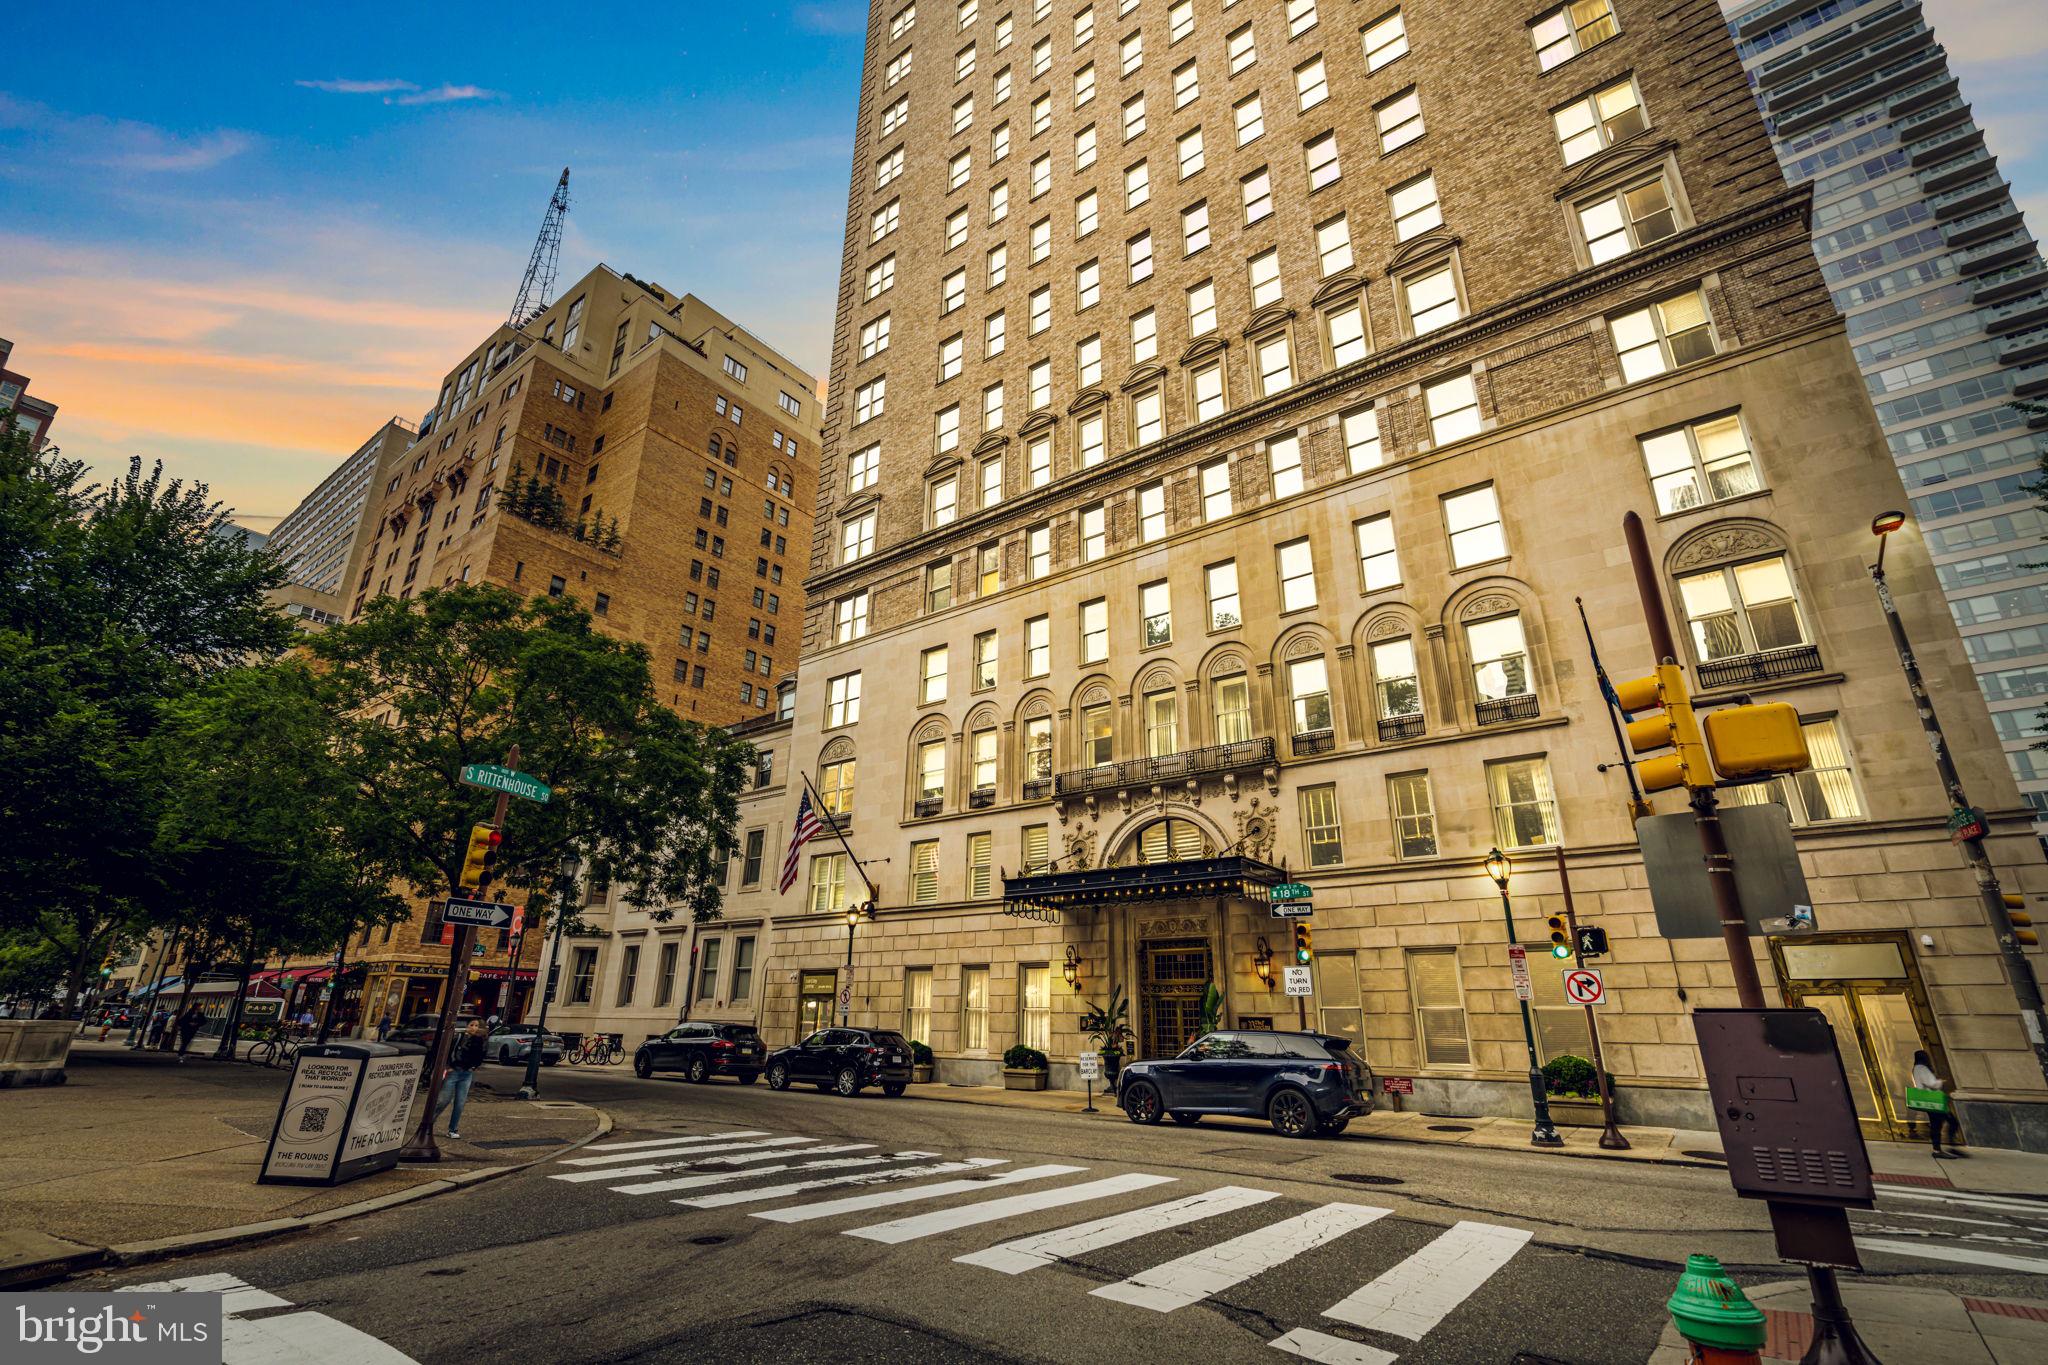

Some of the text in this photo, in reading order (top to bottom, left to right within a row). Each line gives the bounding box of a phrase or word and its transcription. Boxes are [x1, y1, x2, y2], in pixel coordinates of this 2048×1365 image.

[466, 767, 474, 780] S
[477, 769, 538, 798] RITTENHOUSE
[1280, 888, 1300, 898] 18TH
[452, 905, 494, 919] ONE WAY
[1283, 905, 1309, 913] ONE WAY
[1289, 977, 1308, 985] TURN
[377, 1064, 395, 1072] LOOKING
[368, 1071, 392, 1080] RECYCLING
[350, 1127, 402, 1150] THE ROUNDS
[277, 1151, 329, 1161] THE ROUNDS
